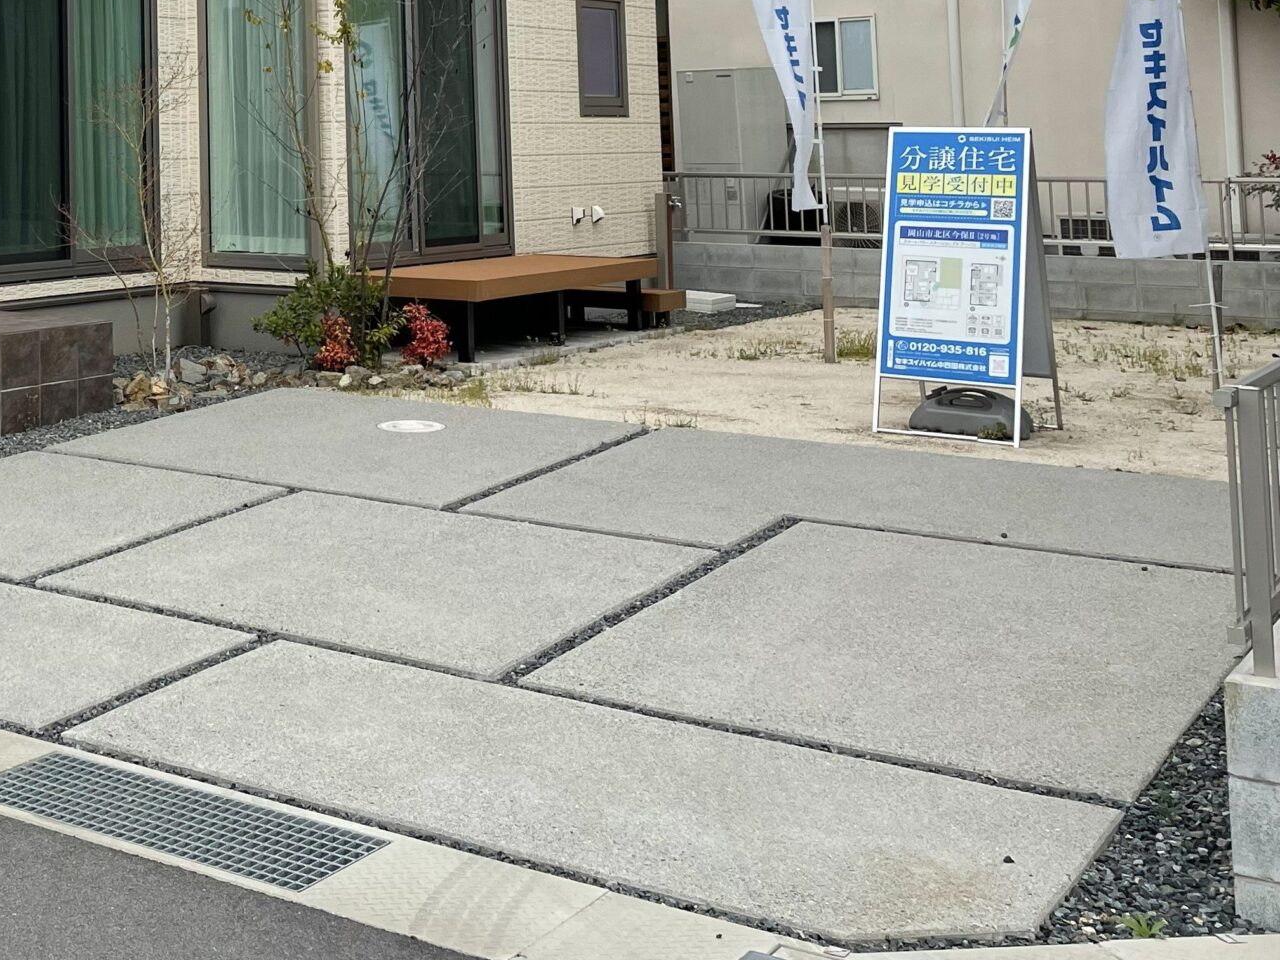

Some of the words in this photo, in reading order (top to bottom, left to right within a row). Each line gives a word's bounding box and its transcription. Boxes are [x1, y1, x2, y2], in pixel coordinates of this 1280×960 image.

[899, 145, 1016, 172] 分譲住宅
[900, 175, 1013, 194] 見学受付中
[909, 341, 987, 357] 0120-935-816
